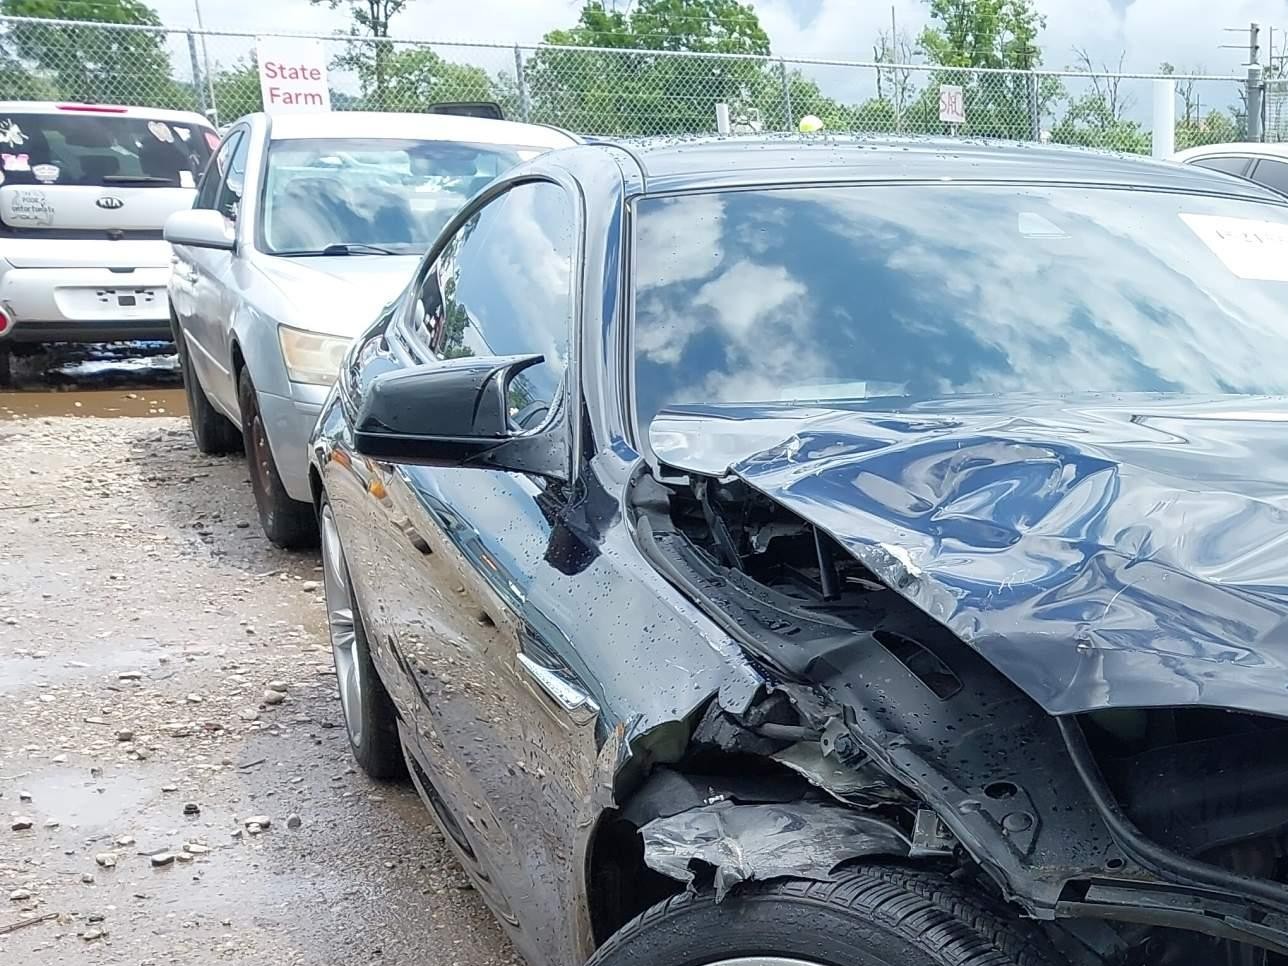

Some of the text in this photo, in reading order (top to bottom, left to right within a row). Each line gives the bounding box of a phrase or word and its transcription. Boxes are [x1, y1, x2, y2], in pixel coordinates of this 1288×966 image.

[264, 61, 321, 81] State
[268, 86, 323, 105] Farm
[98, 197, 122, 208] KIA
